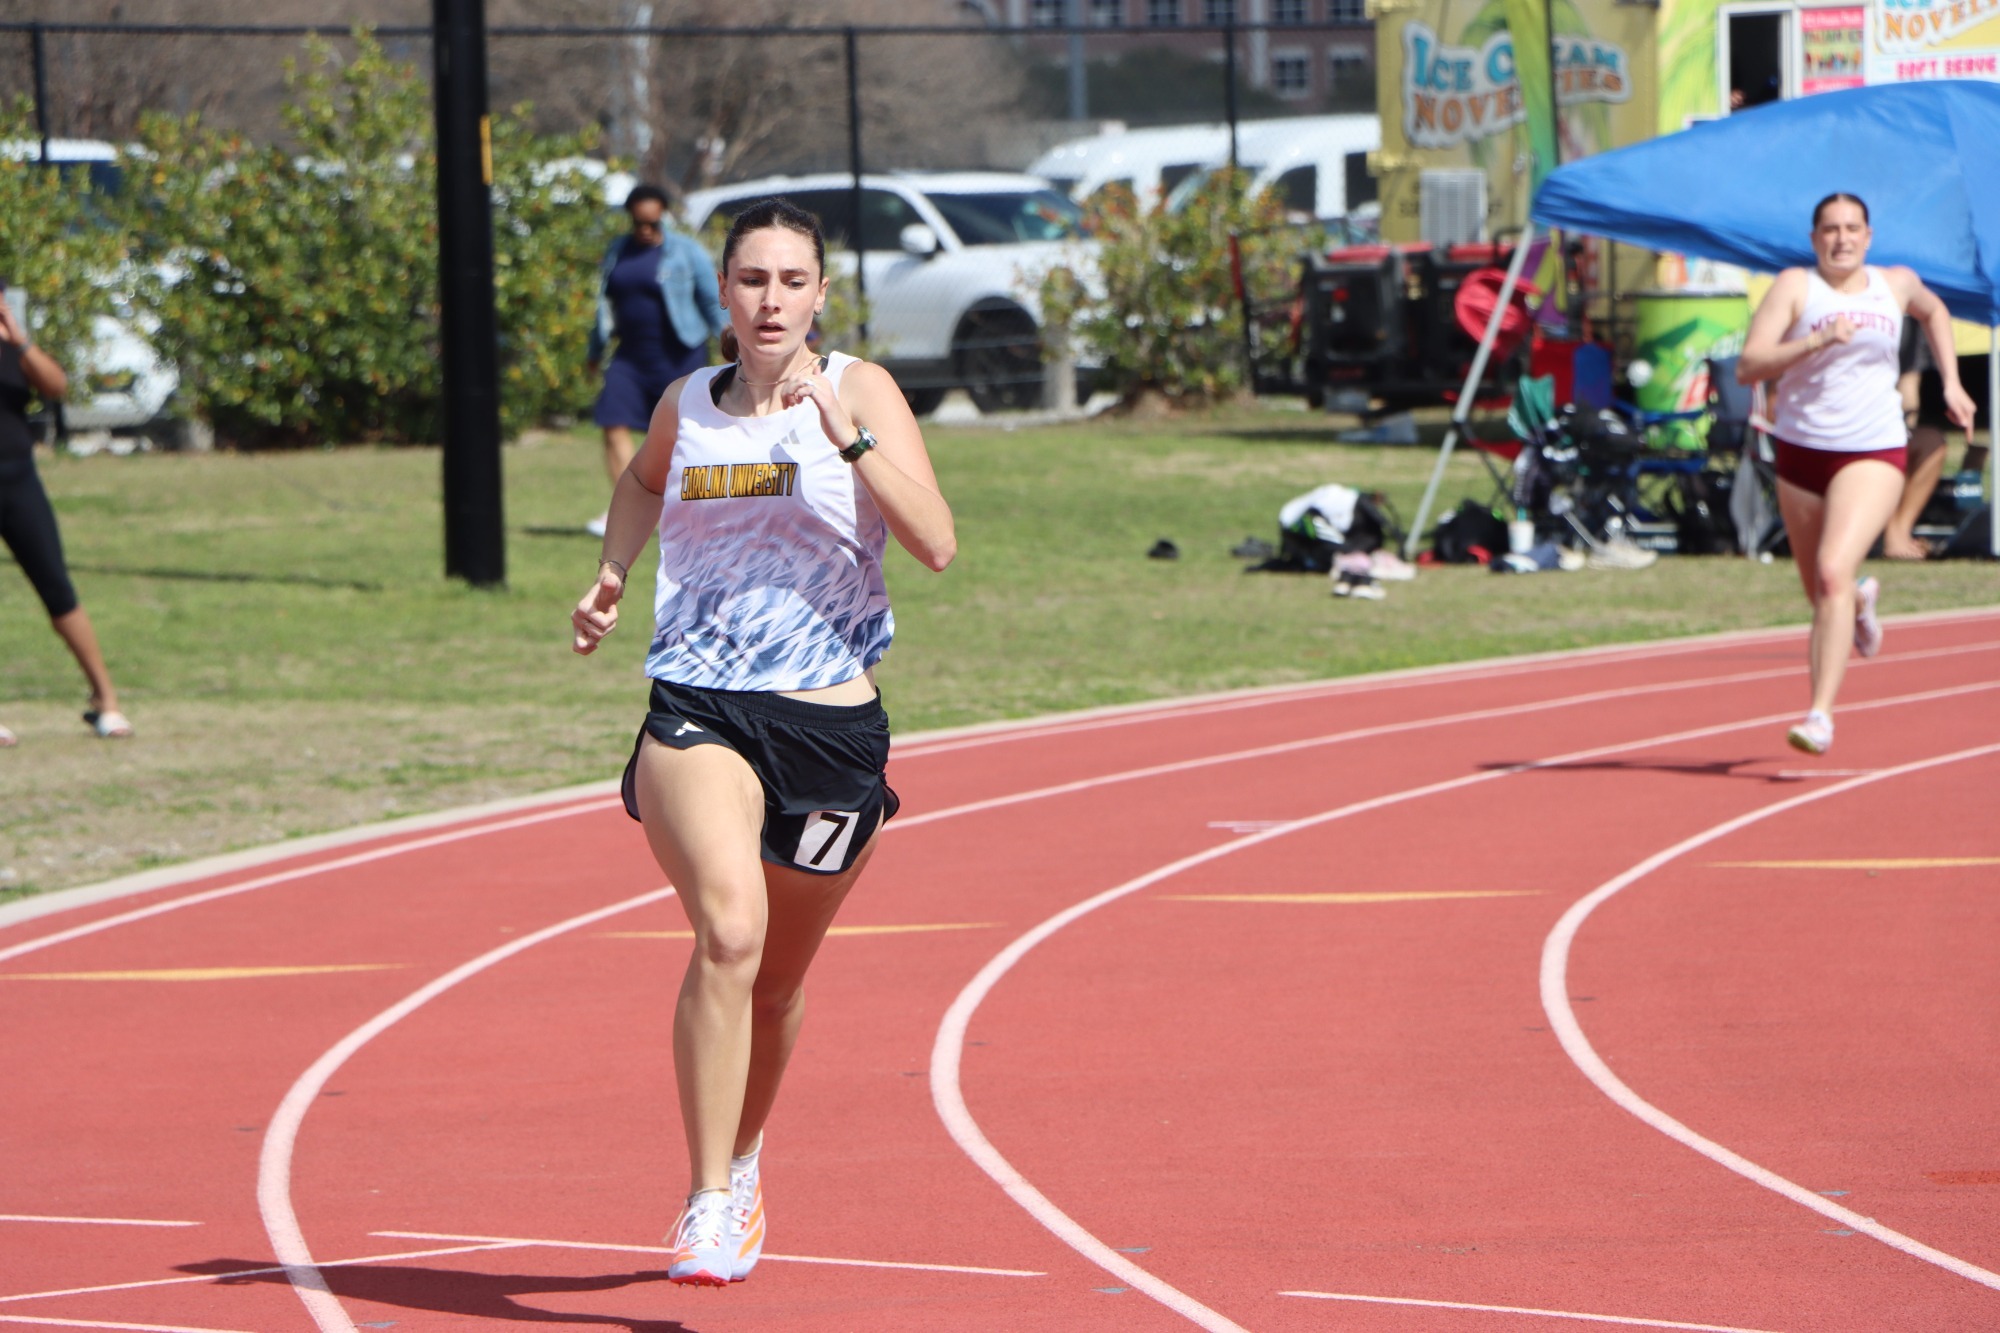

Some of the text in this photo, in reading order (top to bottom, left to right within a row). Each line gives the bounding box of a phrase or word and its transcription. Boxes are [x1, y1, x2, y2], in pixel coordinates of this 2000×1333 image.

[681, 462, 799, 501] CAROLINA UNIVERSITY
[809, 812, 849, 867] 7
